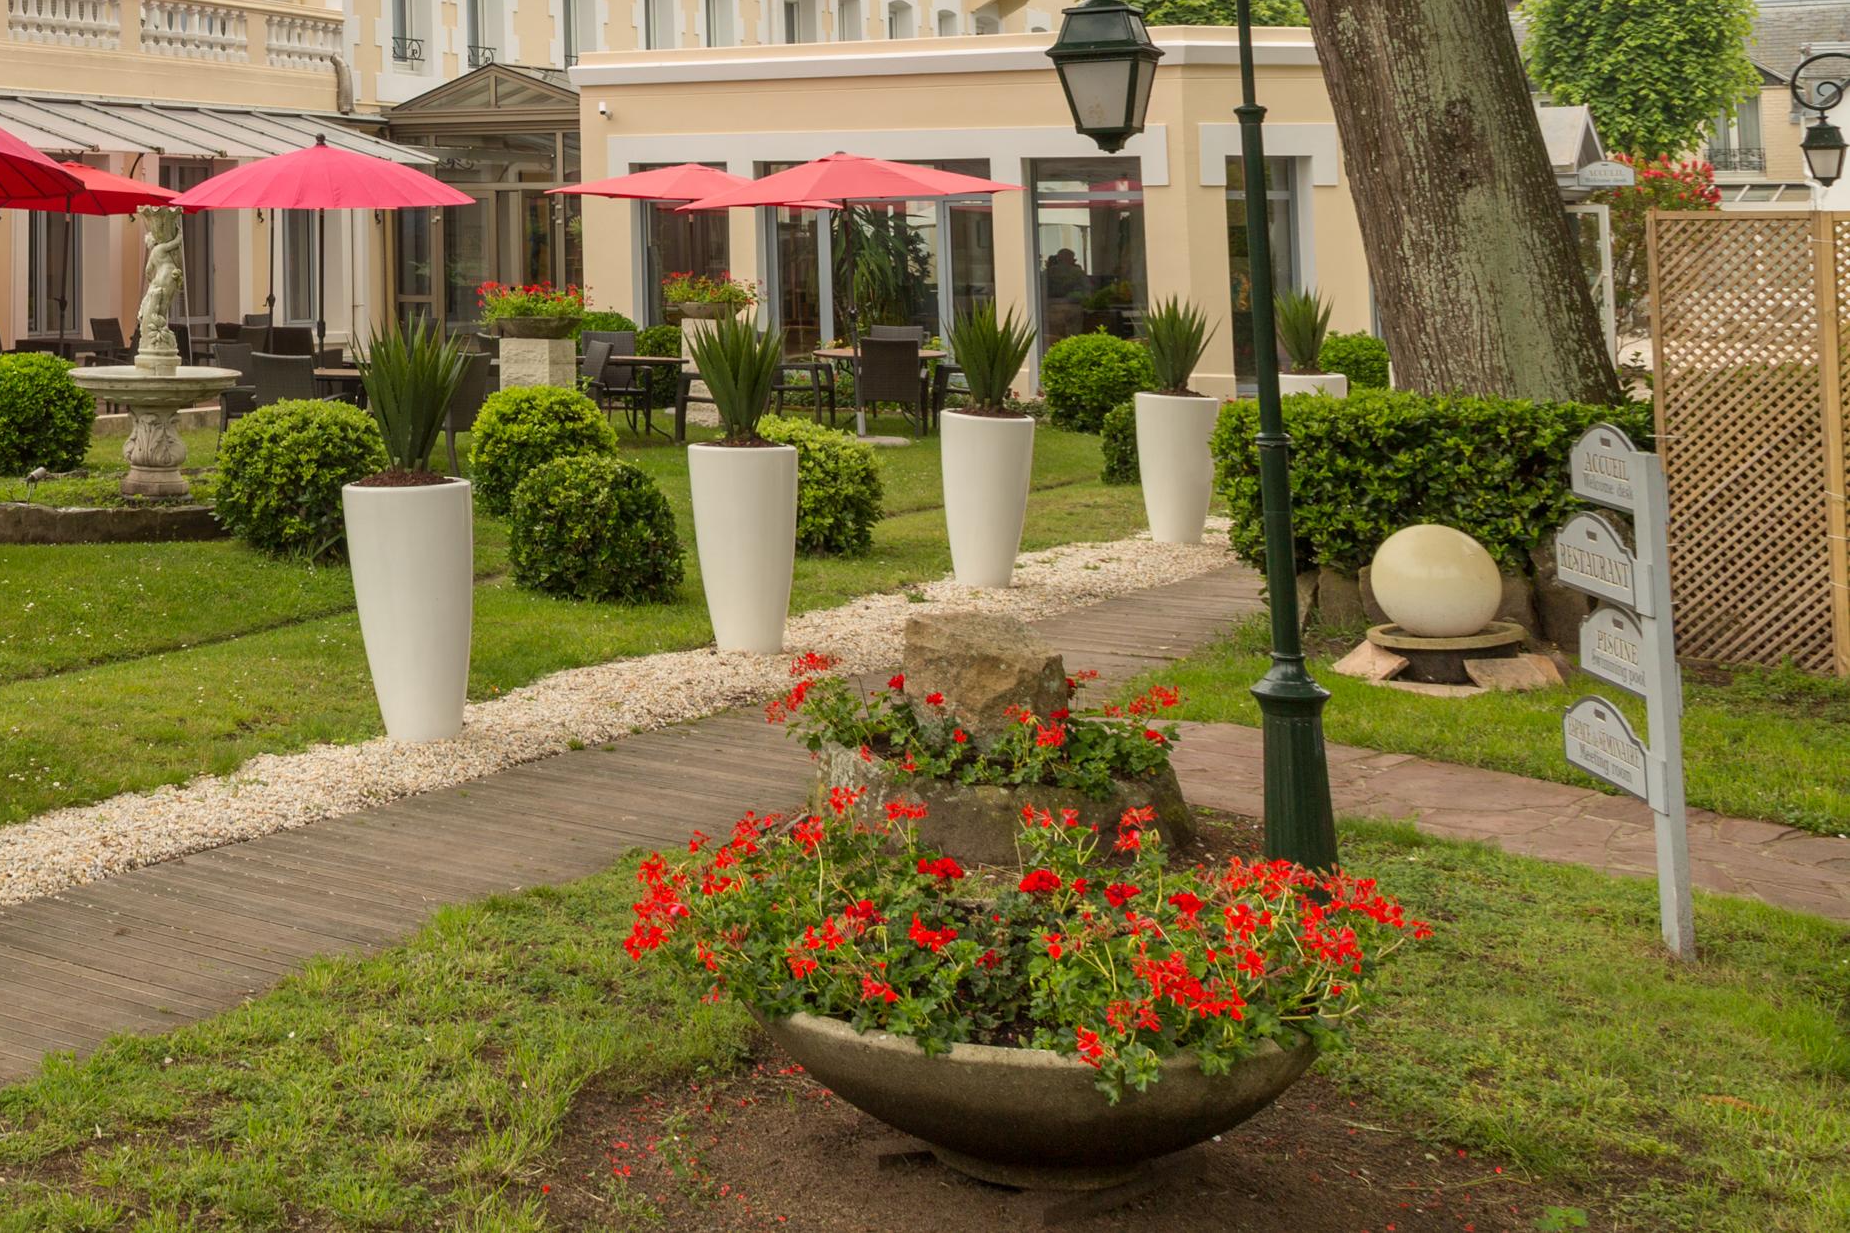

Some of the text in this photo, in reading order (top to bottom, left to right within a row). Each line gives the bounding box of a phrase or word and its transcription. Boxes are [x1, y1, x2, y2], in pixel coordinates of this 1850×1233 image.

[1583, 473, 1614, 494] Welcome
[1584, 451, 1630, 481] ACCUEIL
[1557, 542, 1630, 589] RESTAURANT
[1597, 630, 1639, 666] PISCINE
[1591, 648, 1647, 688] Swimming pool
[1579, 743, 1633, 784] Meeting room
